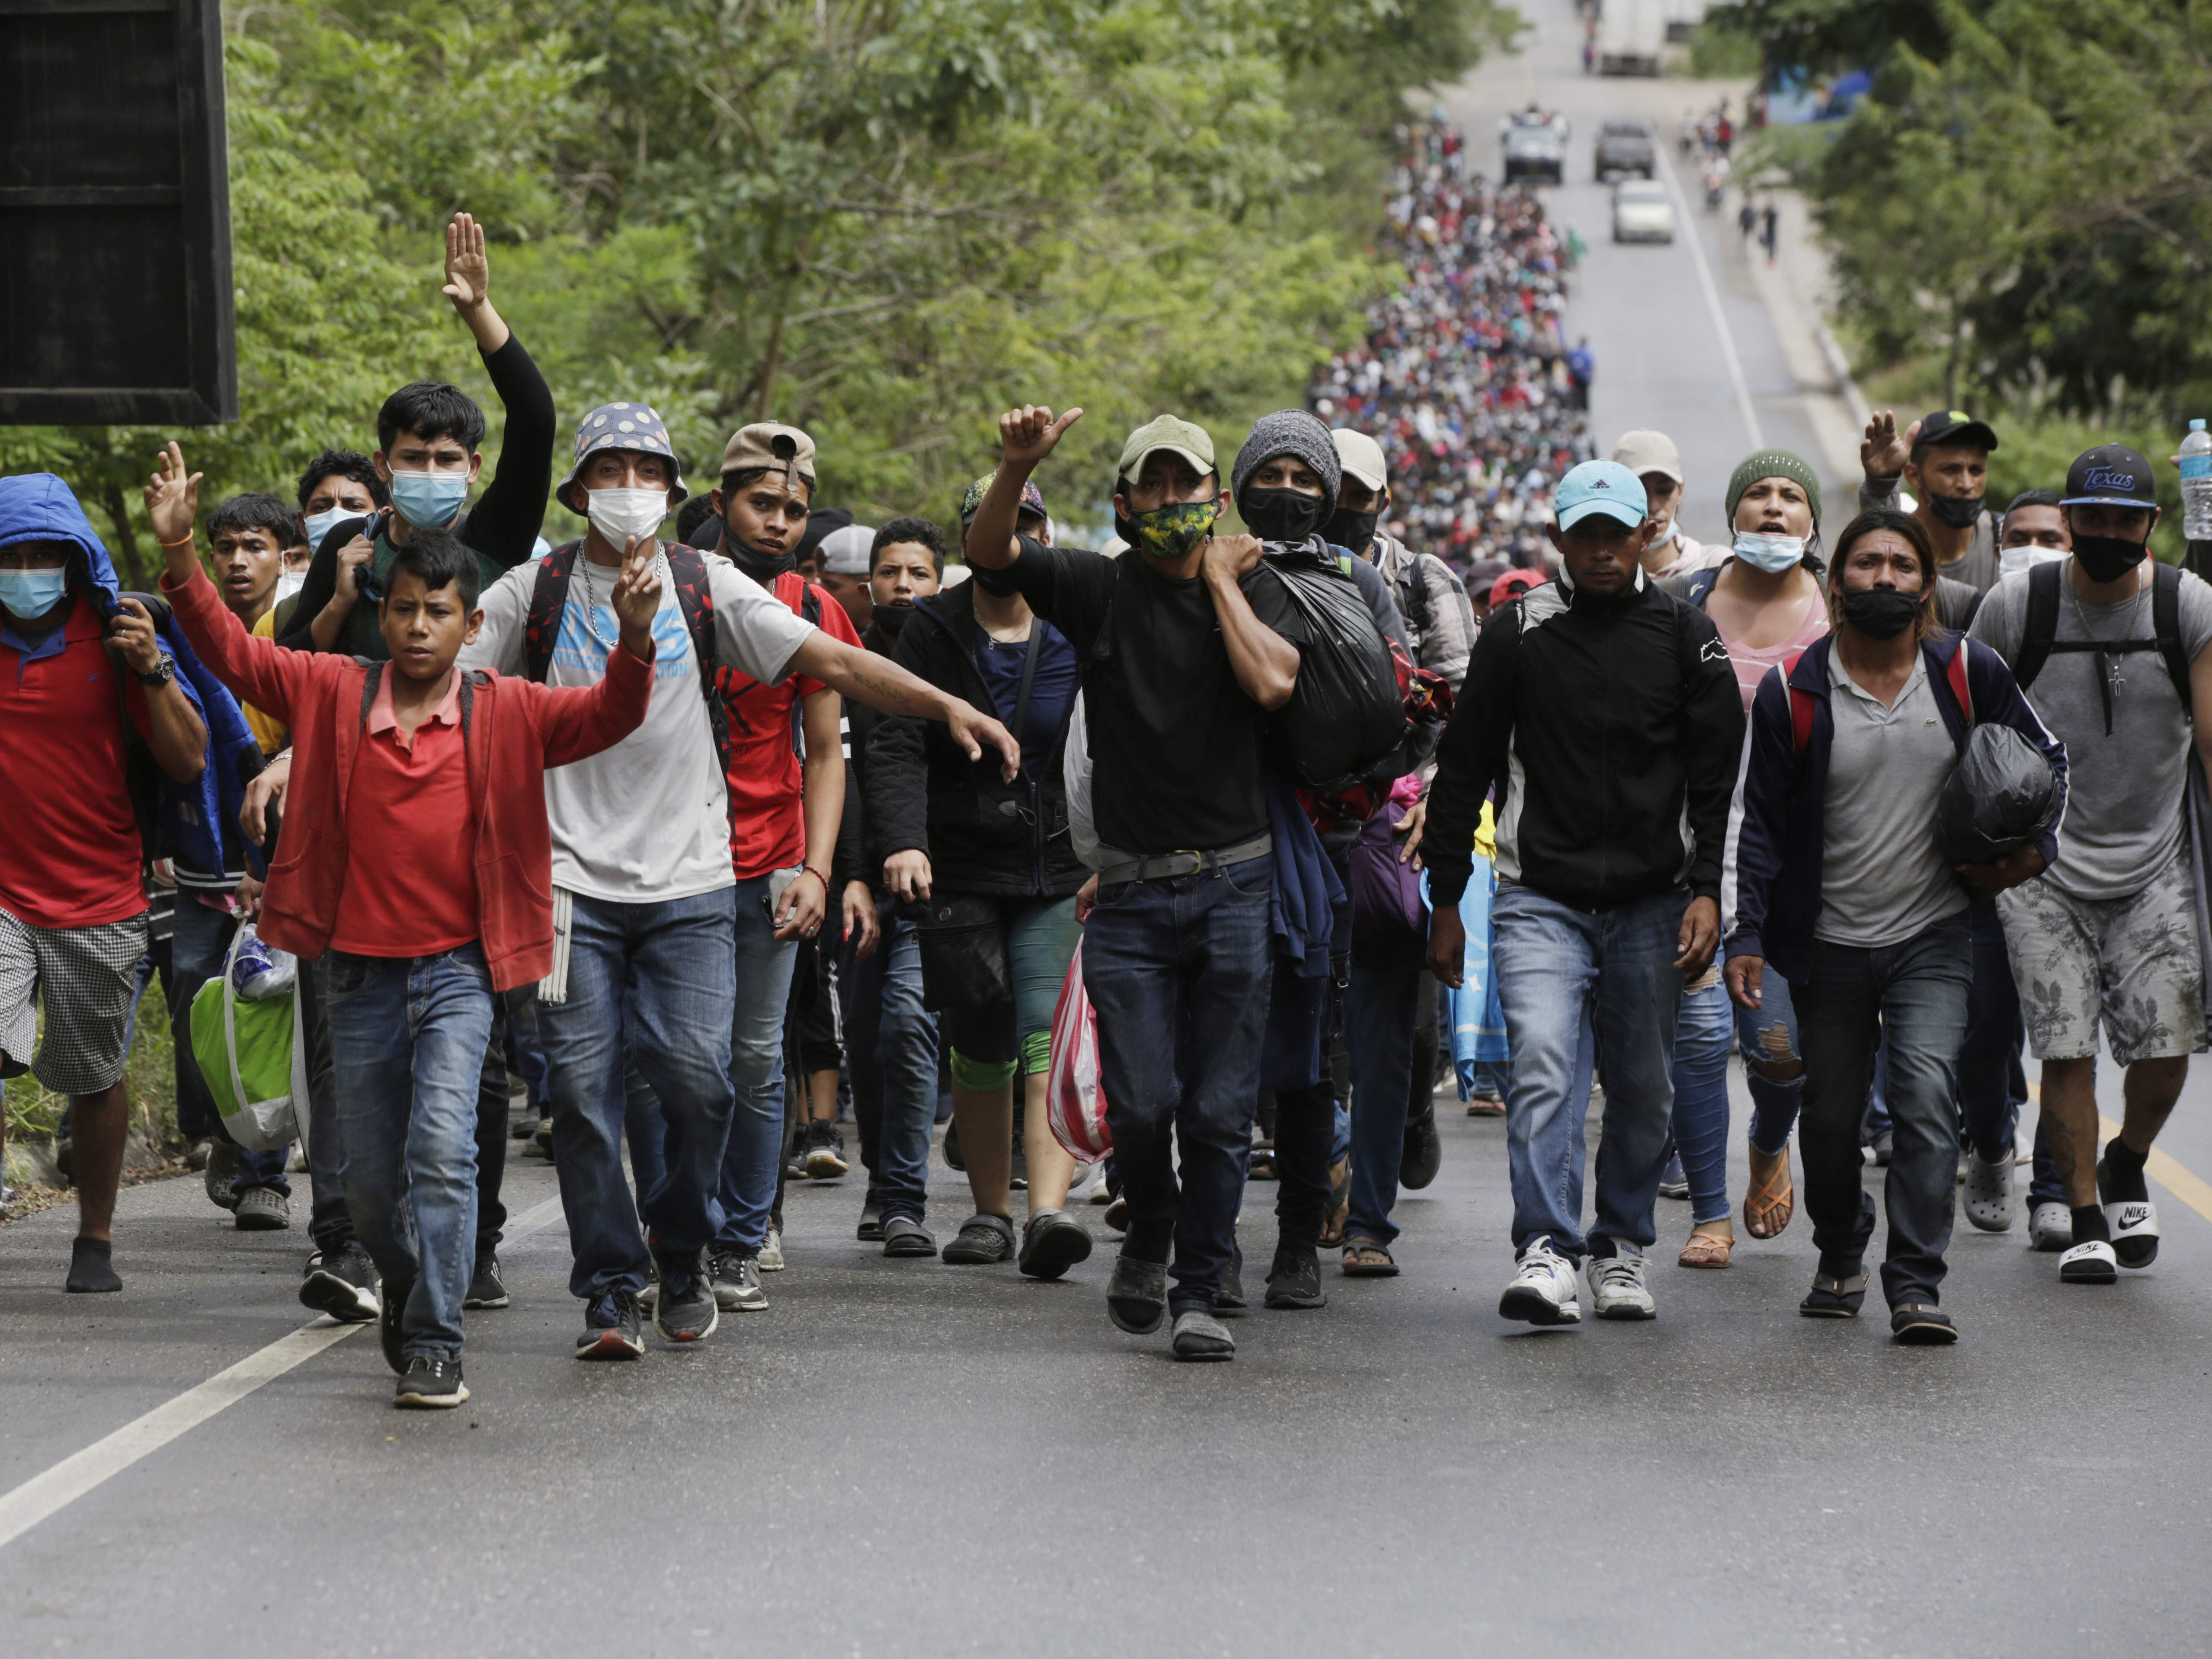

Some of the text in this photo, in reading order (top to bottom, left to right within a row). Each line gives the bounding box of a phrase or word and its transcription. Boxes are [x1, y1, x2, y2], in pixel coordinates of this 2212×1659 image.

[2084, 465, 2135, 492] Texas
[552, 650, 607, 672] HYSICA
[2124, 1206, 2148, 1218] NIKE
[1620, 1243, 1638, 1256] Wilson
[2073, 1243, 2102, 1255] NIKE
